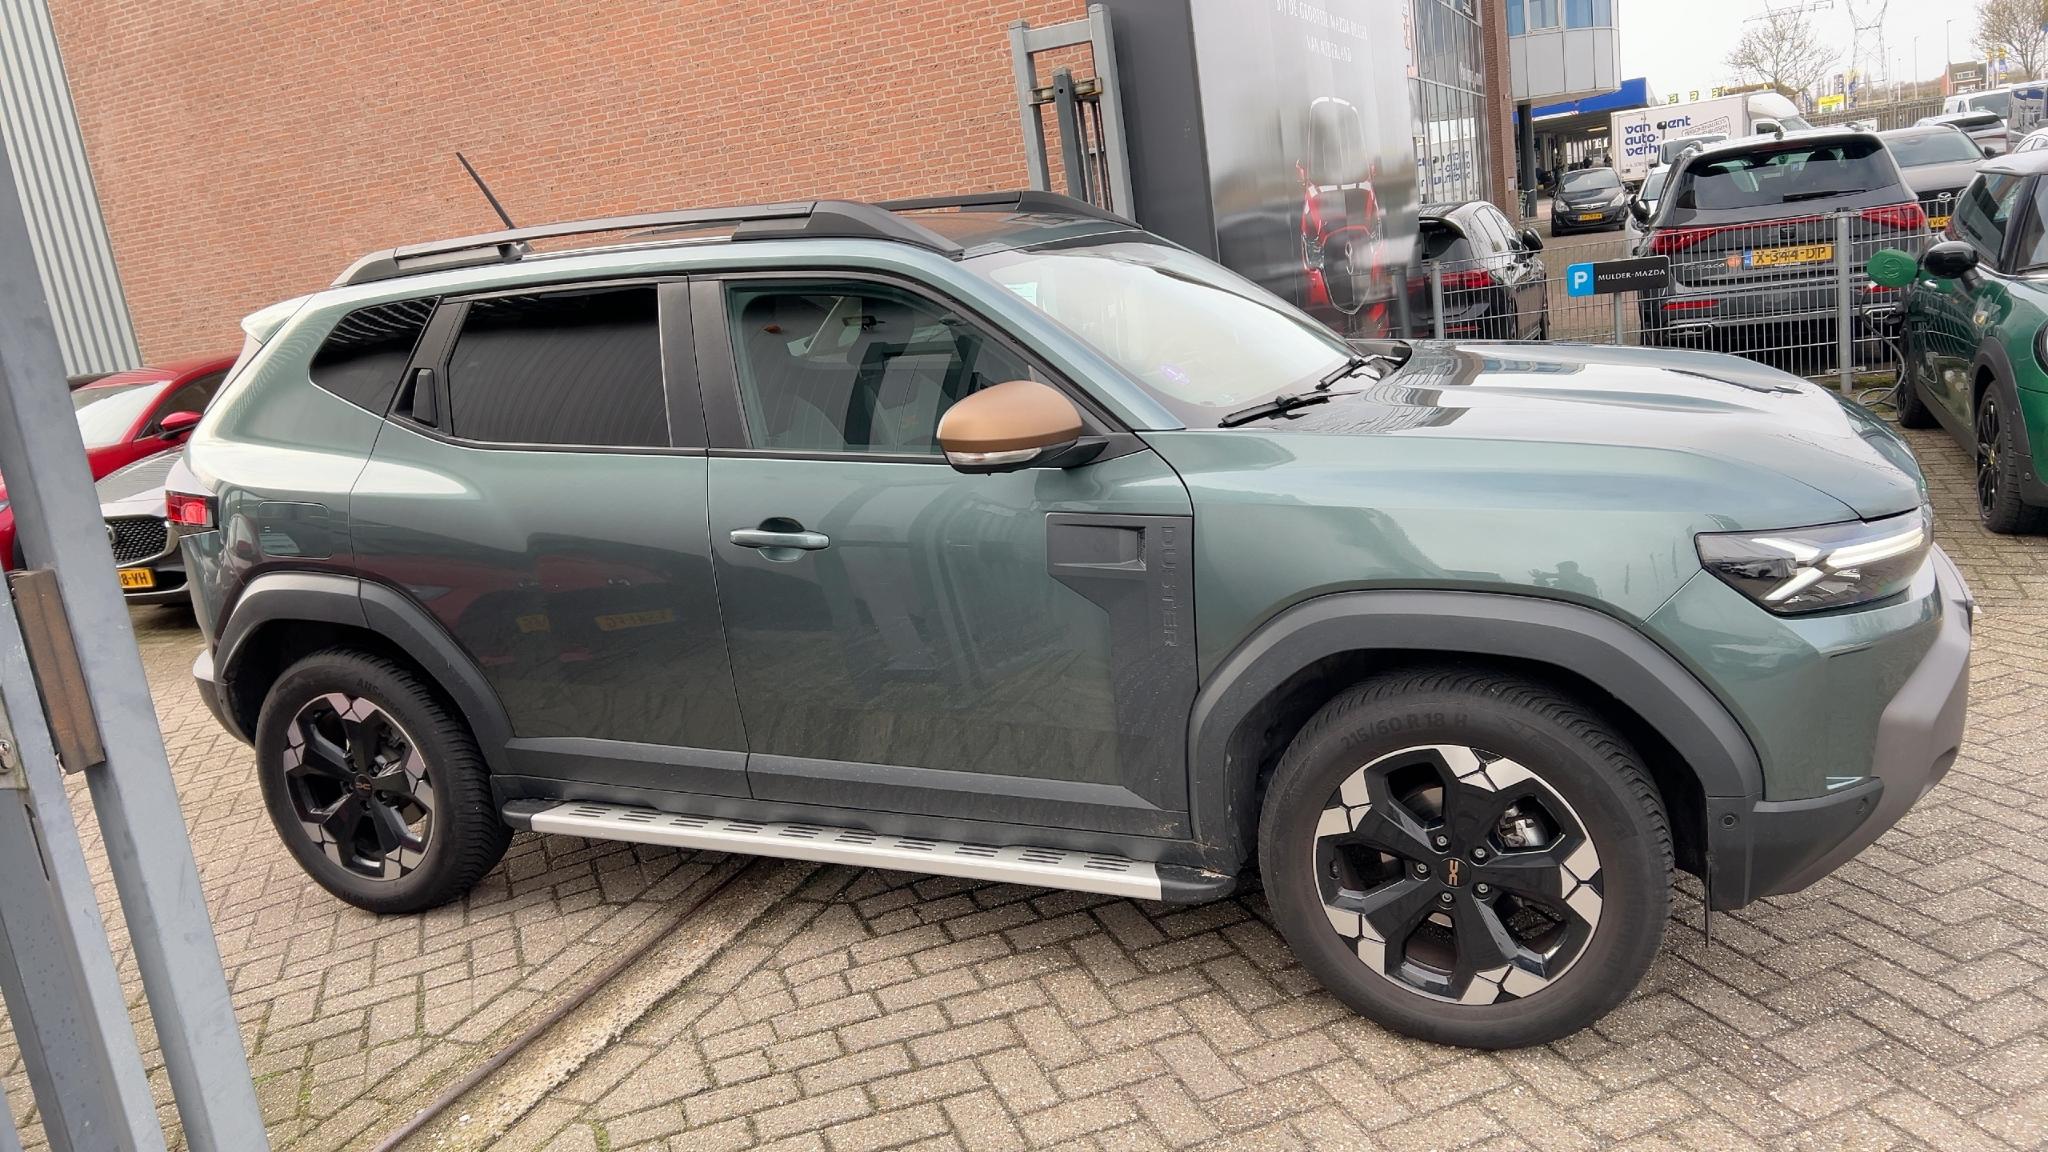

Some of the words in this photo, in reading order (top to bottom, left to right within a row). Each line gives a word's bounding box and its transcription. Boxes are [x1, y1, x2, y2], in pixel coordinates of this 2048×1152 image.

[1624, 123, 1651, 135] van
[1667, 115, 1691, 129] ent
[1755, 247, 1826, 265] X-344-DP
[1574, 271, 1588, 289] P
[1598, 268, 1666, 281] MULDER-MAZDA
[1161, 526, 1178, 647] DUSTER
